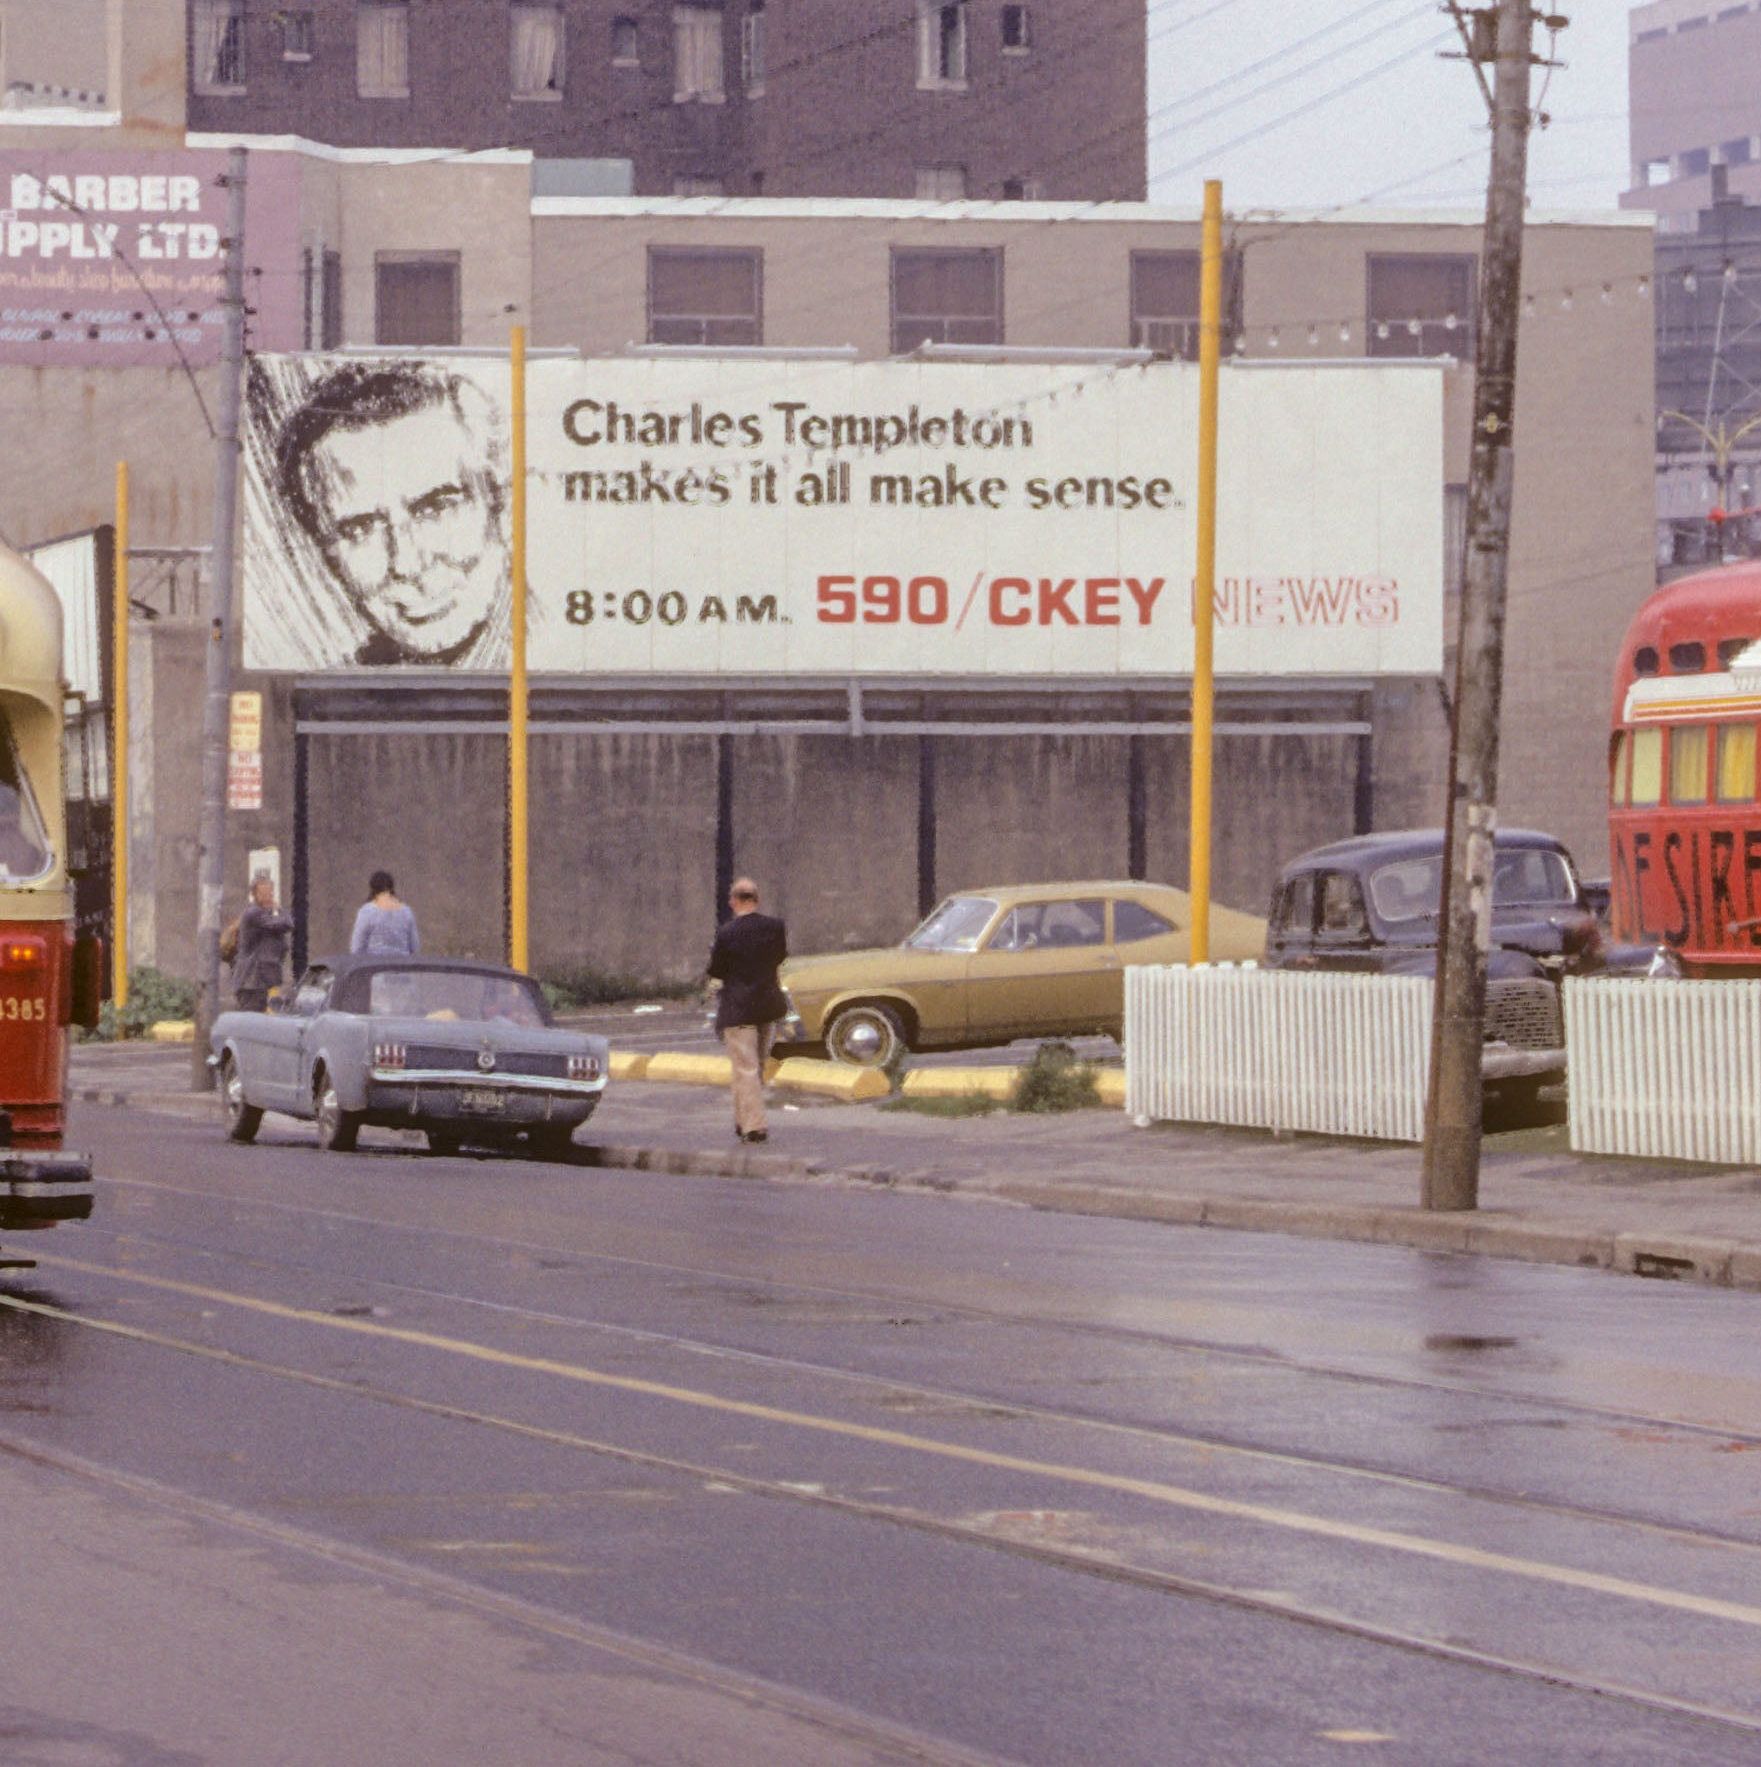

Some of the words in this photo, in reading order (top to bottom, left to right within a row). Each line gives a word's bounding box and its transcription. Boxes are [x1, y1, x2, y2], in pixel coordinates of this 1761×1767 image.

[11, 173, 200, 212] BARBER
[139, 222, 228, 259] LTD.
[561, 398, 763, 448] Charles
[774, 400, 1034, 455] Templeton
[563, 463, 728, 509] makes
[750, 461, 777, 505] it
[796, 462, 851, 506] all
[870, 462, 1007, 509] make
[1027, 470, 1187, 511] sense.
[564, 589, 687, 626] 8:00
[817, 572, 1165, 634] 590/CKEY
[1190, 577, 1401, 628] NEWS
